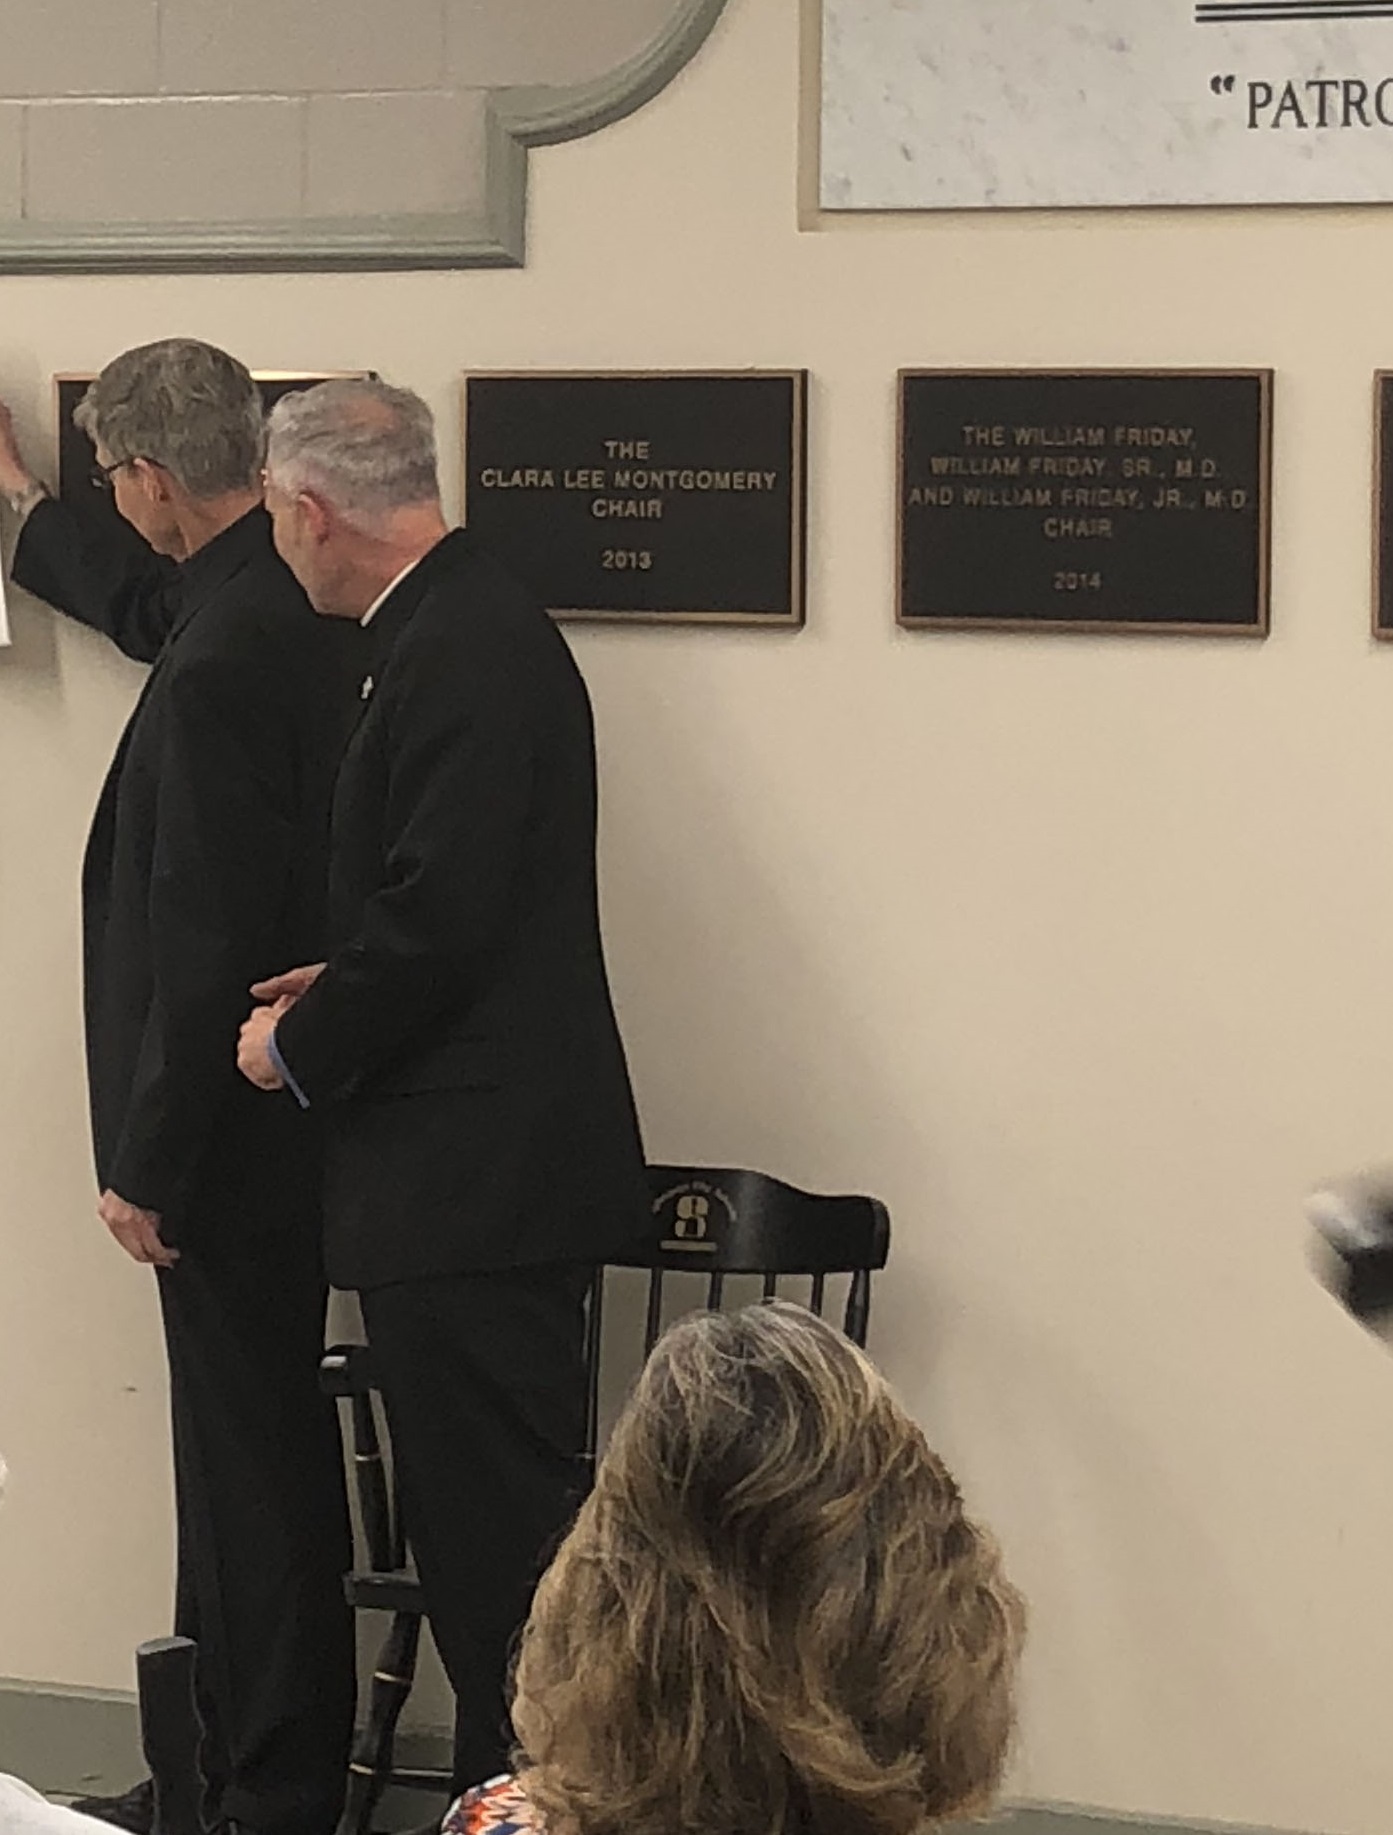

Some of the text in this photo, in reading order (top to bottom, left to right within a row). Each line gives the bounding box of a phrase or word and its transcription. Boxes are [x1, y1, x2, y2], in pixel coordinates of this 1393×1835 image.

[963, 426, 1006, 446] THE
[1014, 427, 1105, 446] WILLIAM
[605, 441, 650, 459] THE
[930, 457, 1021, 476] WILLIAM
[481, 468, 776, 491] CLARA LEE MONTGOMERY
[908, 486, 954, 506] AND
[963, 486, 1052, 507] WILLIAM
[591, 499, 662, 518] CHAIR
[1044, 518, 1112, 538] CHAIR
[602, 551, 652, 570] 2013
[1054, 571, 1101, 590] 2014
